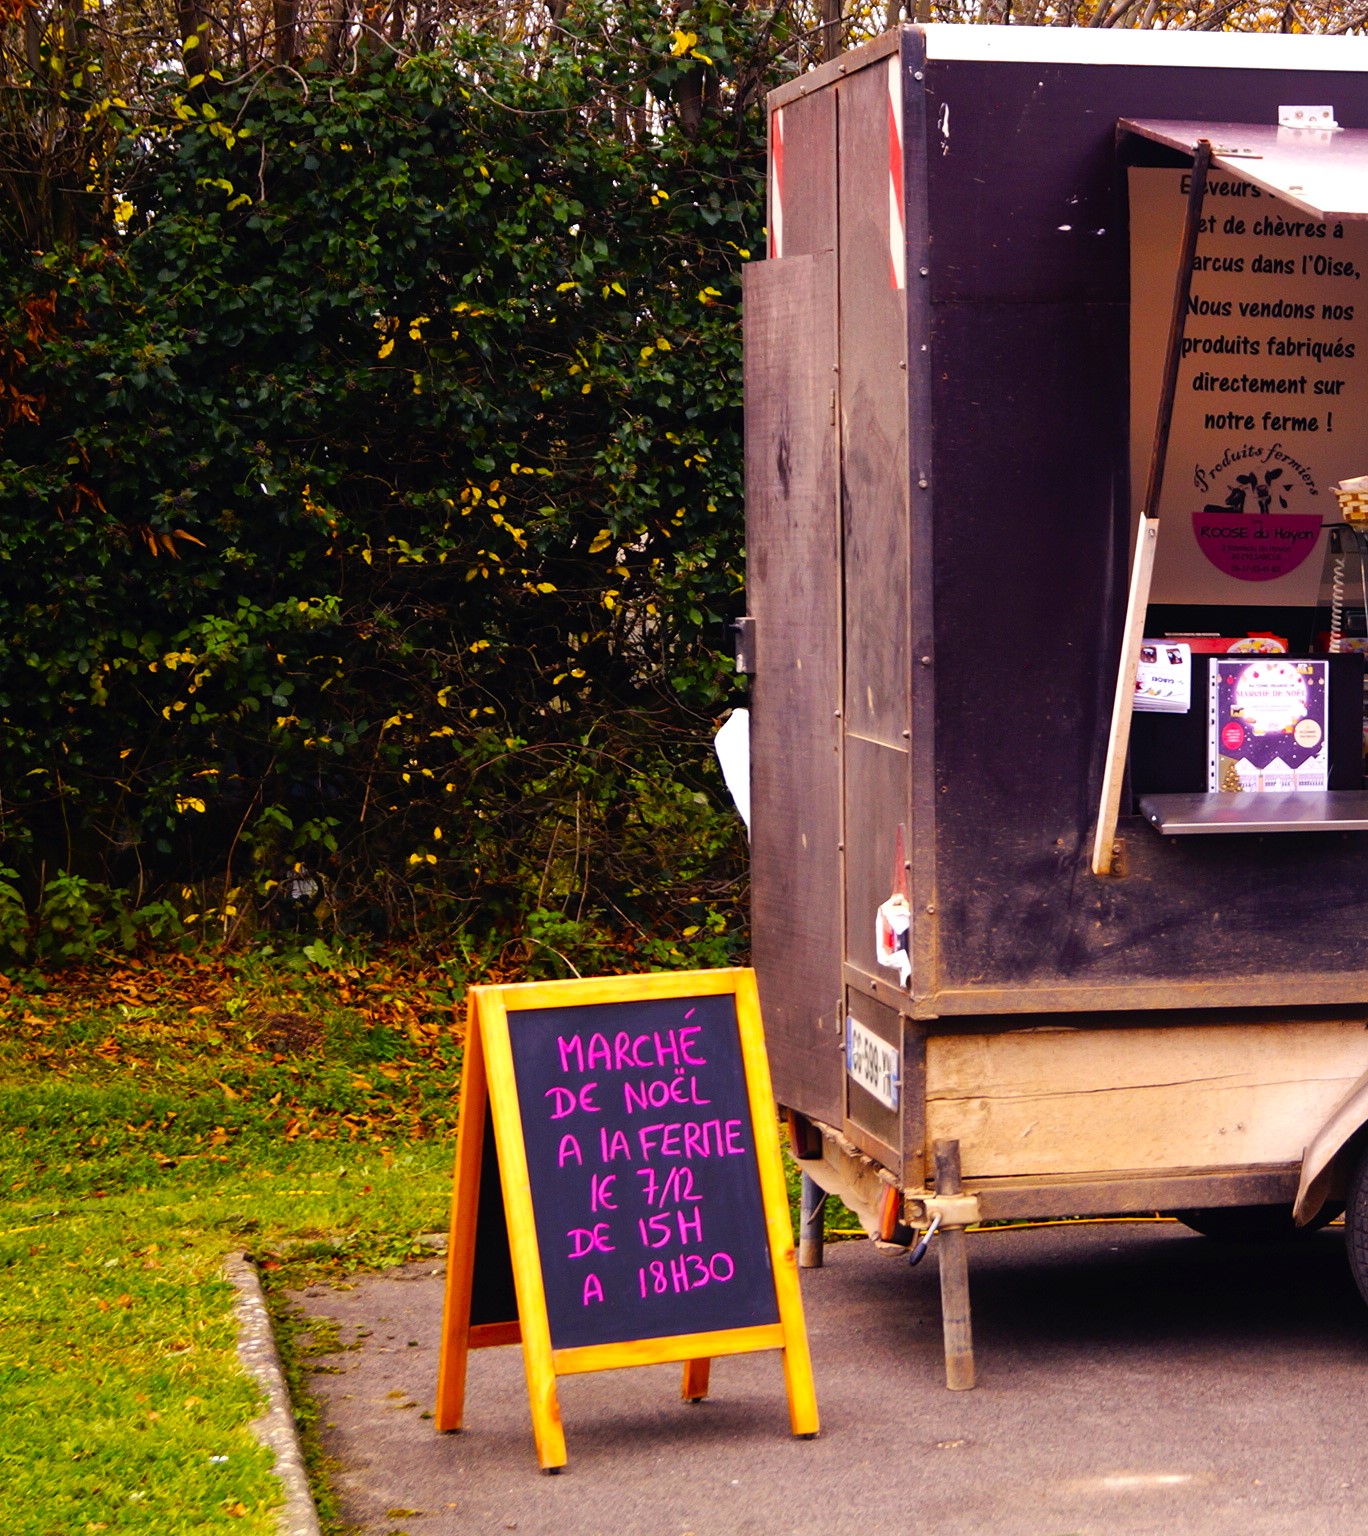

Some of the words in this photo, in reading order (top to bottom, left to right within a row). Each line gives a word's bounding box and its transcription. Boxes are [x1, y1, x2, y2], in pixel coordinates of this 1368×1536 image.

[1180, 175, 1261, 198] Eveurs
[1199, 215, 1217, 234] et
[1223, 215, 1246, 235] de
[1253, 215, 1326, 238] chèvres
[1193, 256, 1244, 273] arcus
[1251, 255, 1295, 275] dans
[1302, 255, 1361, 279] l'Oise,
[1186, 295, 1232, 317] Nous
[1239, 299, 1315, 320] vendons
[1321, 304, 1354, 321] nos
[1181, 336, 1260, 359] produits
[1267, 336, 1355, 363] fabriqués
[1192, 372, 1307, 394] directement
[1314, 378, 1345, 395] sur
[1204, 413, 1255, 431] notre
[1261, 411, 1319, 432] ferme
[1326, 411, 1333, 433] !
[1193, 443, 1263, 493] Produits
[1260, 442, 1319, 496] fermiers
[1200, 526, 1248, 539] ROOSE
[557, 1007, 706, 1073] MARCHÉ
[544, 1082, 601, 1120] DE
[624, 1067, 711, 1114] NOËL
[558, 1133, 583, 1168] A
[638, 1119, 746, 1161] FERME
[636, 1166, 703, 1209] 7/12
[566, 1222, 617, 1259] DE
[638, 1205, 703, 1248] 15H
[583, 1273, 604, 1306] A
[638, 1252, 735, 1298] 18H30
